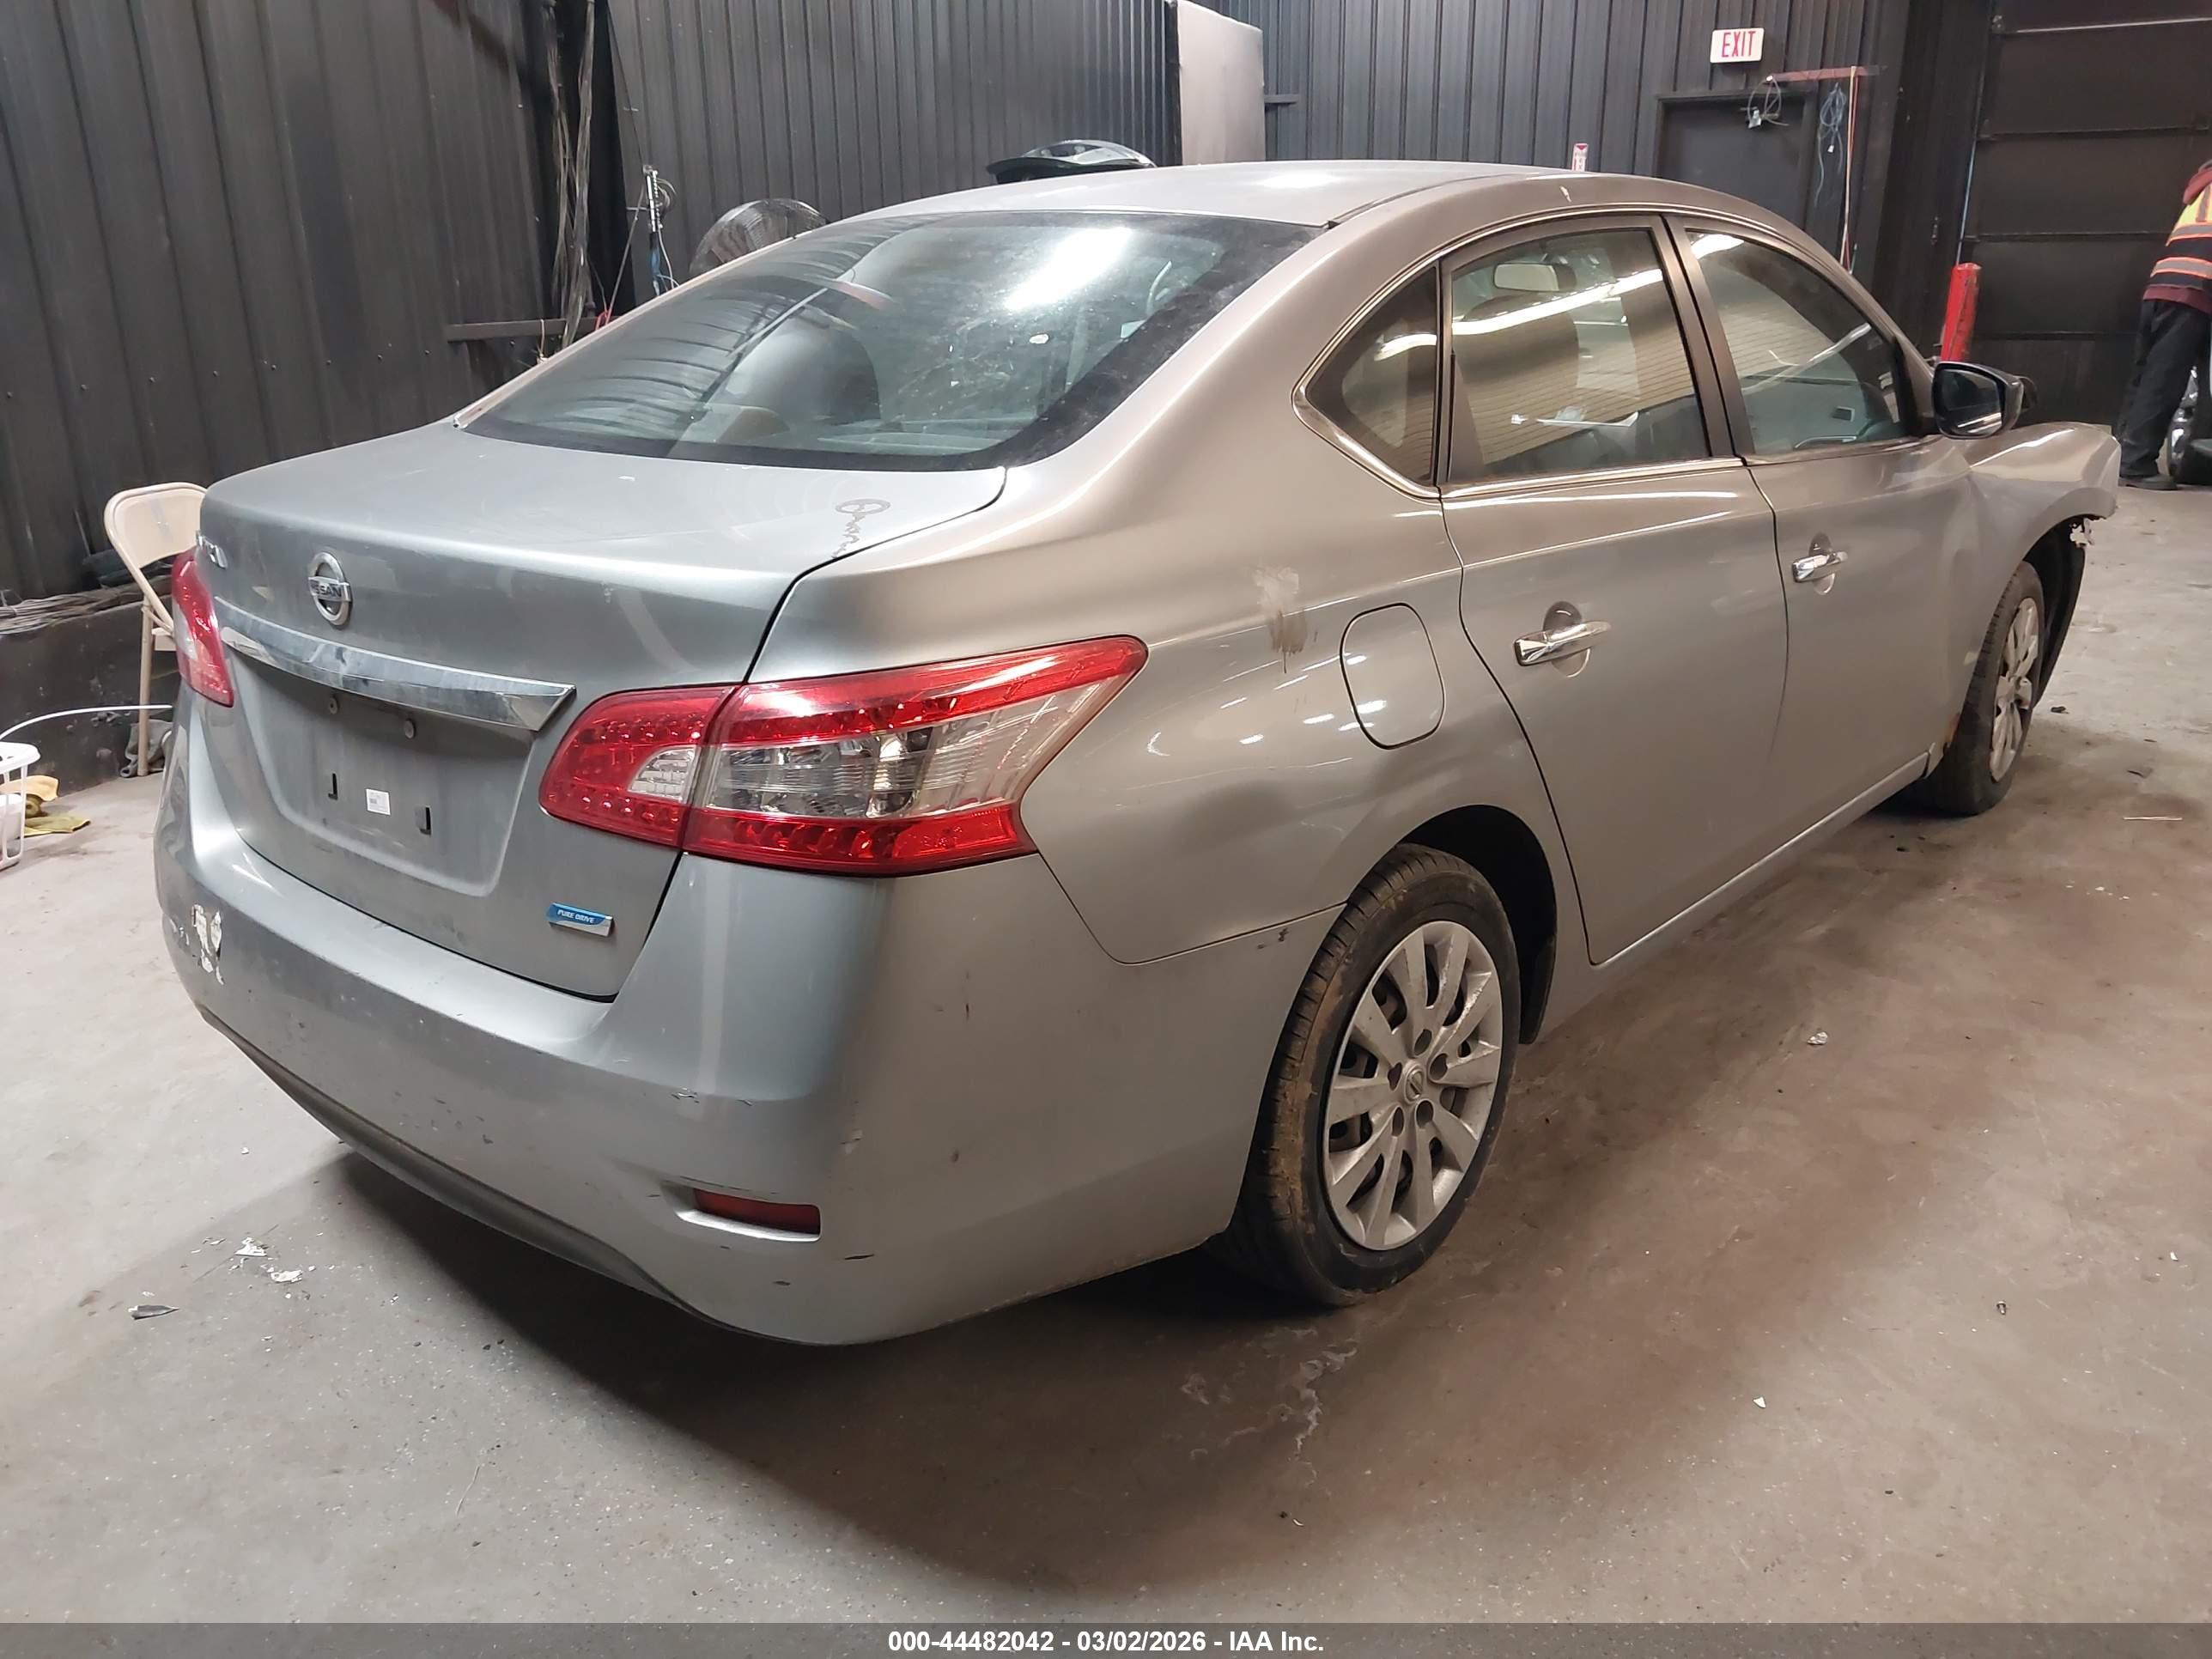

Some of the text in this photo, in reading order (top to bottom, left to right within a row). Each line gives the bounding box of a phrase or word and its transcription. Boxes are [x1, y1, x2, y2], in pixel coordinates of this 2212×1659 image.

[1722, 31, 1756, 58] EXIT
[557, 909, 594, 923] PURE DRIVE
